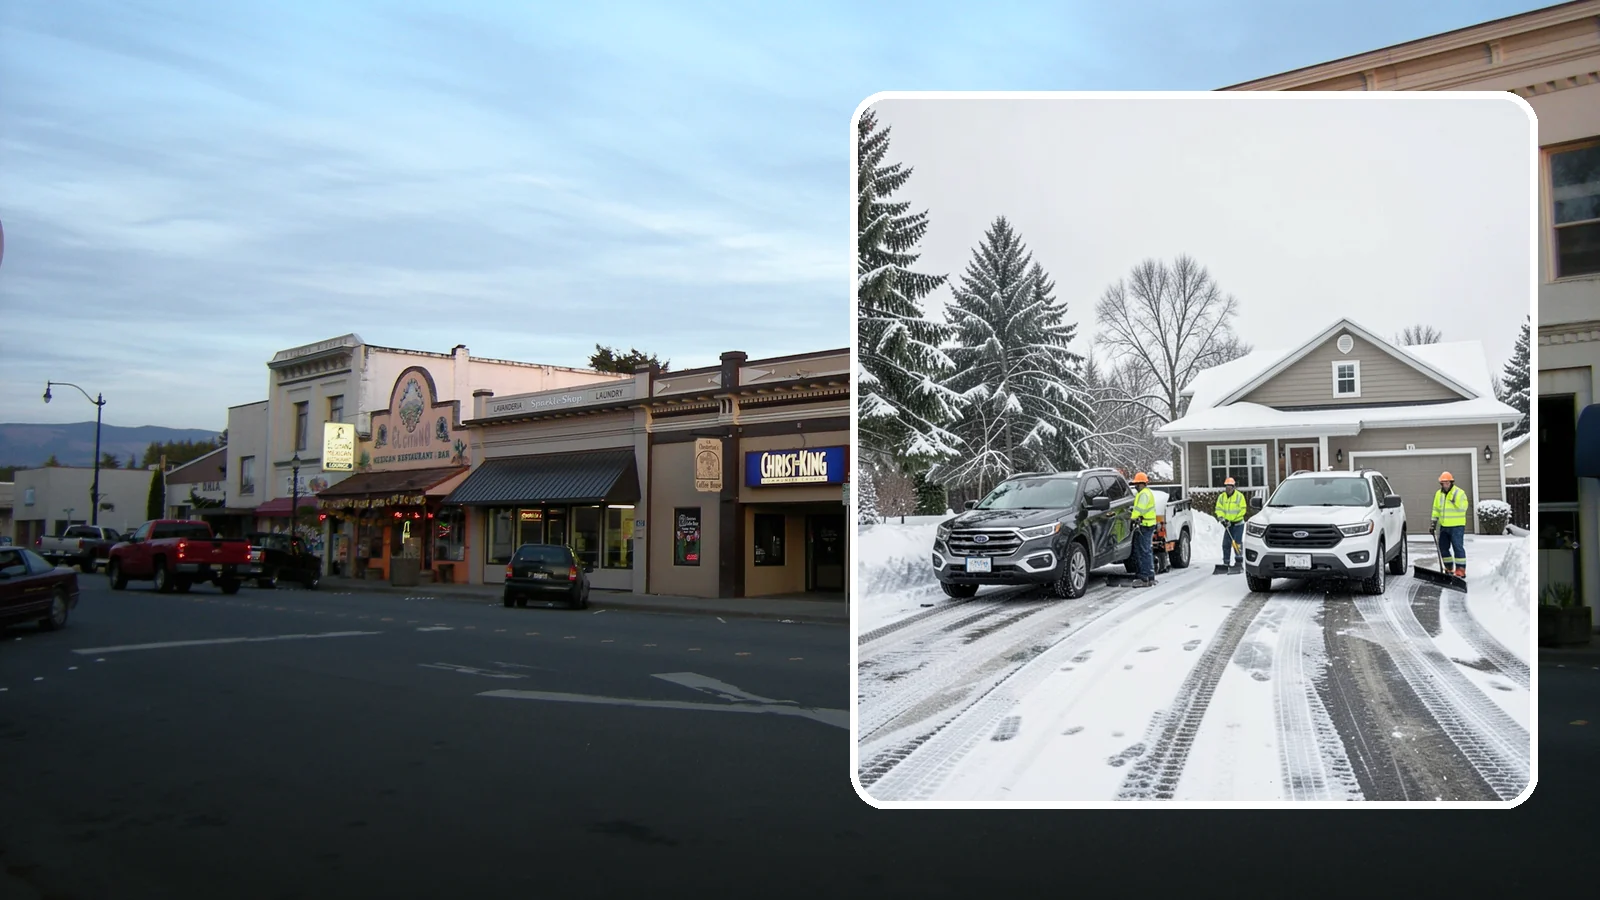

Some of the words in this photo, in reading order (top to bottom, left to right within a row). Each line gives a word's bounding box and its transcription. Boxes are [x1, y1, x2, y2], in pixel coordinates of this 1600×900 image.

[596, 389, 623, 399] LAUNDRY
[531, 396, 561, 408] Sparkle
[562, 394, 582, 405] Shop
[494, 403, 522, 412] LAVANDERIA
[374, 456, 396, 464] MEXICAN
[398, 451, 433, 462] RESTAURANT
[438, 450, 450, 459] BAR
